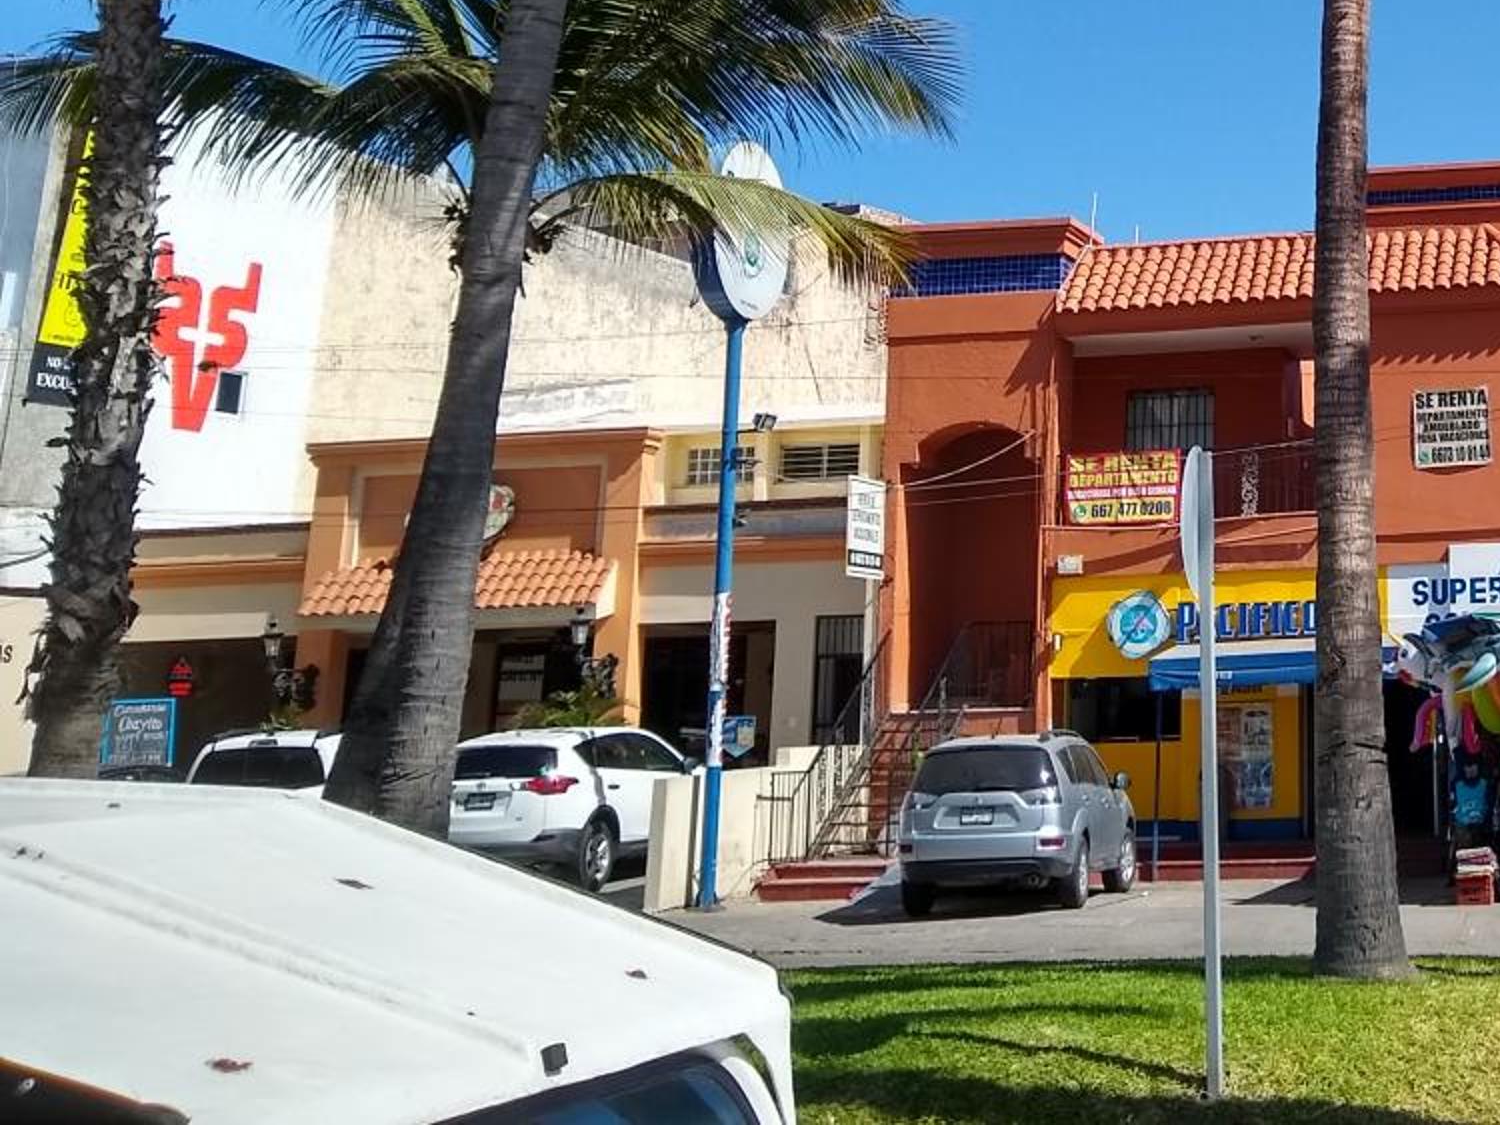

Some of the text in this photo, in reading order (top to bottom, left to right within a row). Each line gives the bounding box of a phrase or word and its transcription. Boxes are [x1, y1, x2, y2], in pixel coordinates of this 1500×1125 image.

[1415, 389, 1487, 409] SE RENTA
[1416, 408, 1489, 422] DEPARTAMENTO
[1069, 452, 1177, 473] SE RENTA
[1069, 470, 1177, 488] DEPARTAMENTO
